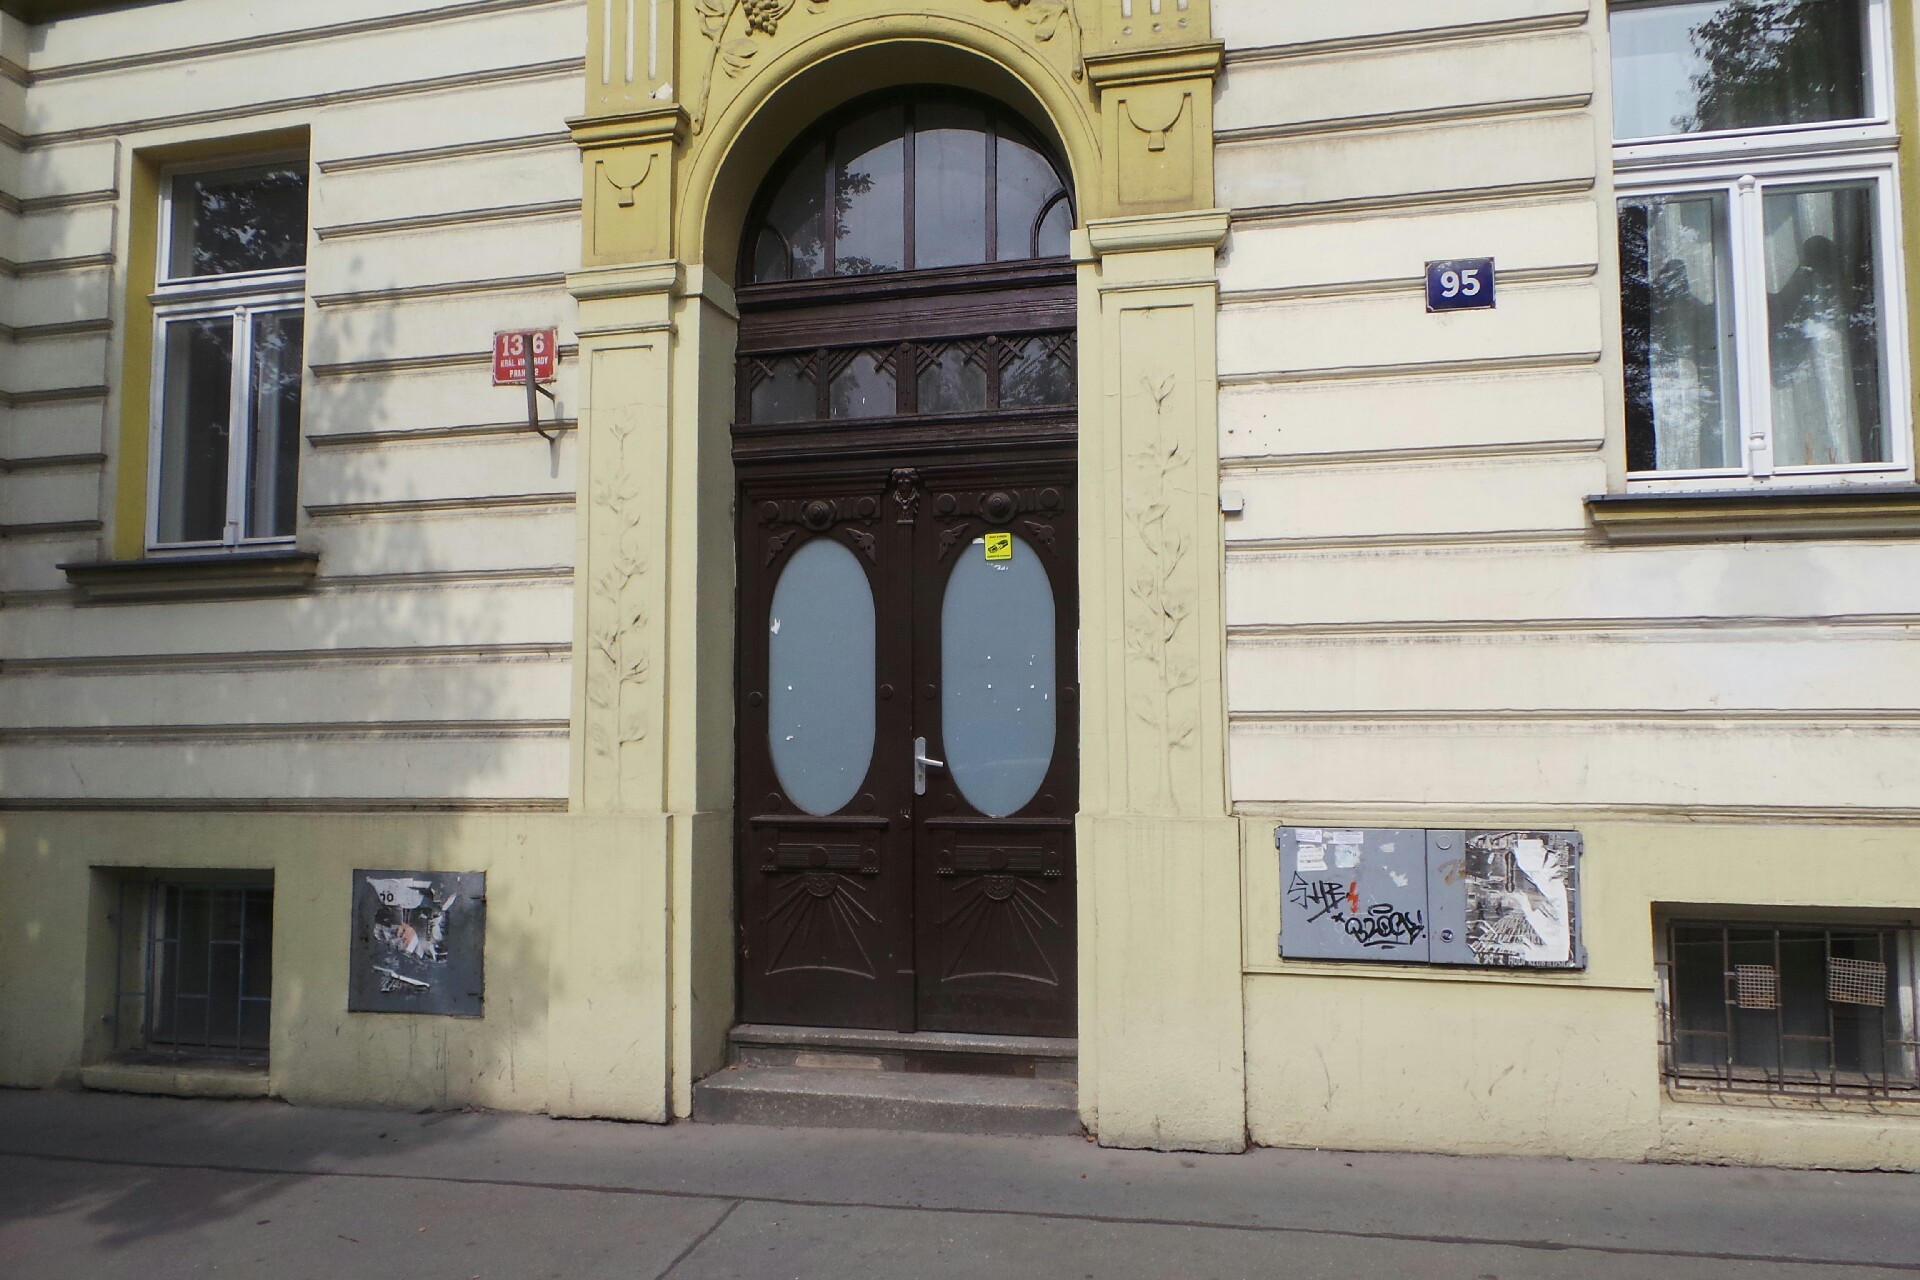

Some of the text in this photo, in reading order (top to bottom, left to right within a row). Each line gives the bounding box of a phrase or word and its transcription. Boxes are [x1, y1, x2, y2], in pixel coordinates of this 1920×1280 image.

[1441, 269, 1480, 298] 95
[517, 356, 549, 366] VINRADY
[509, 368, 539, 378] PRAH 2
